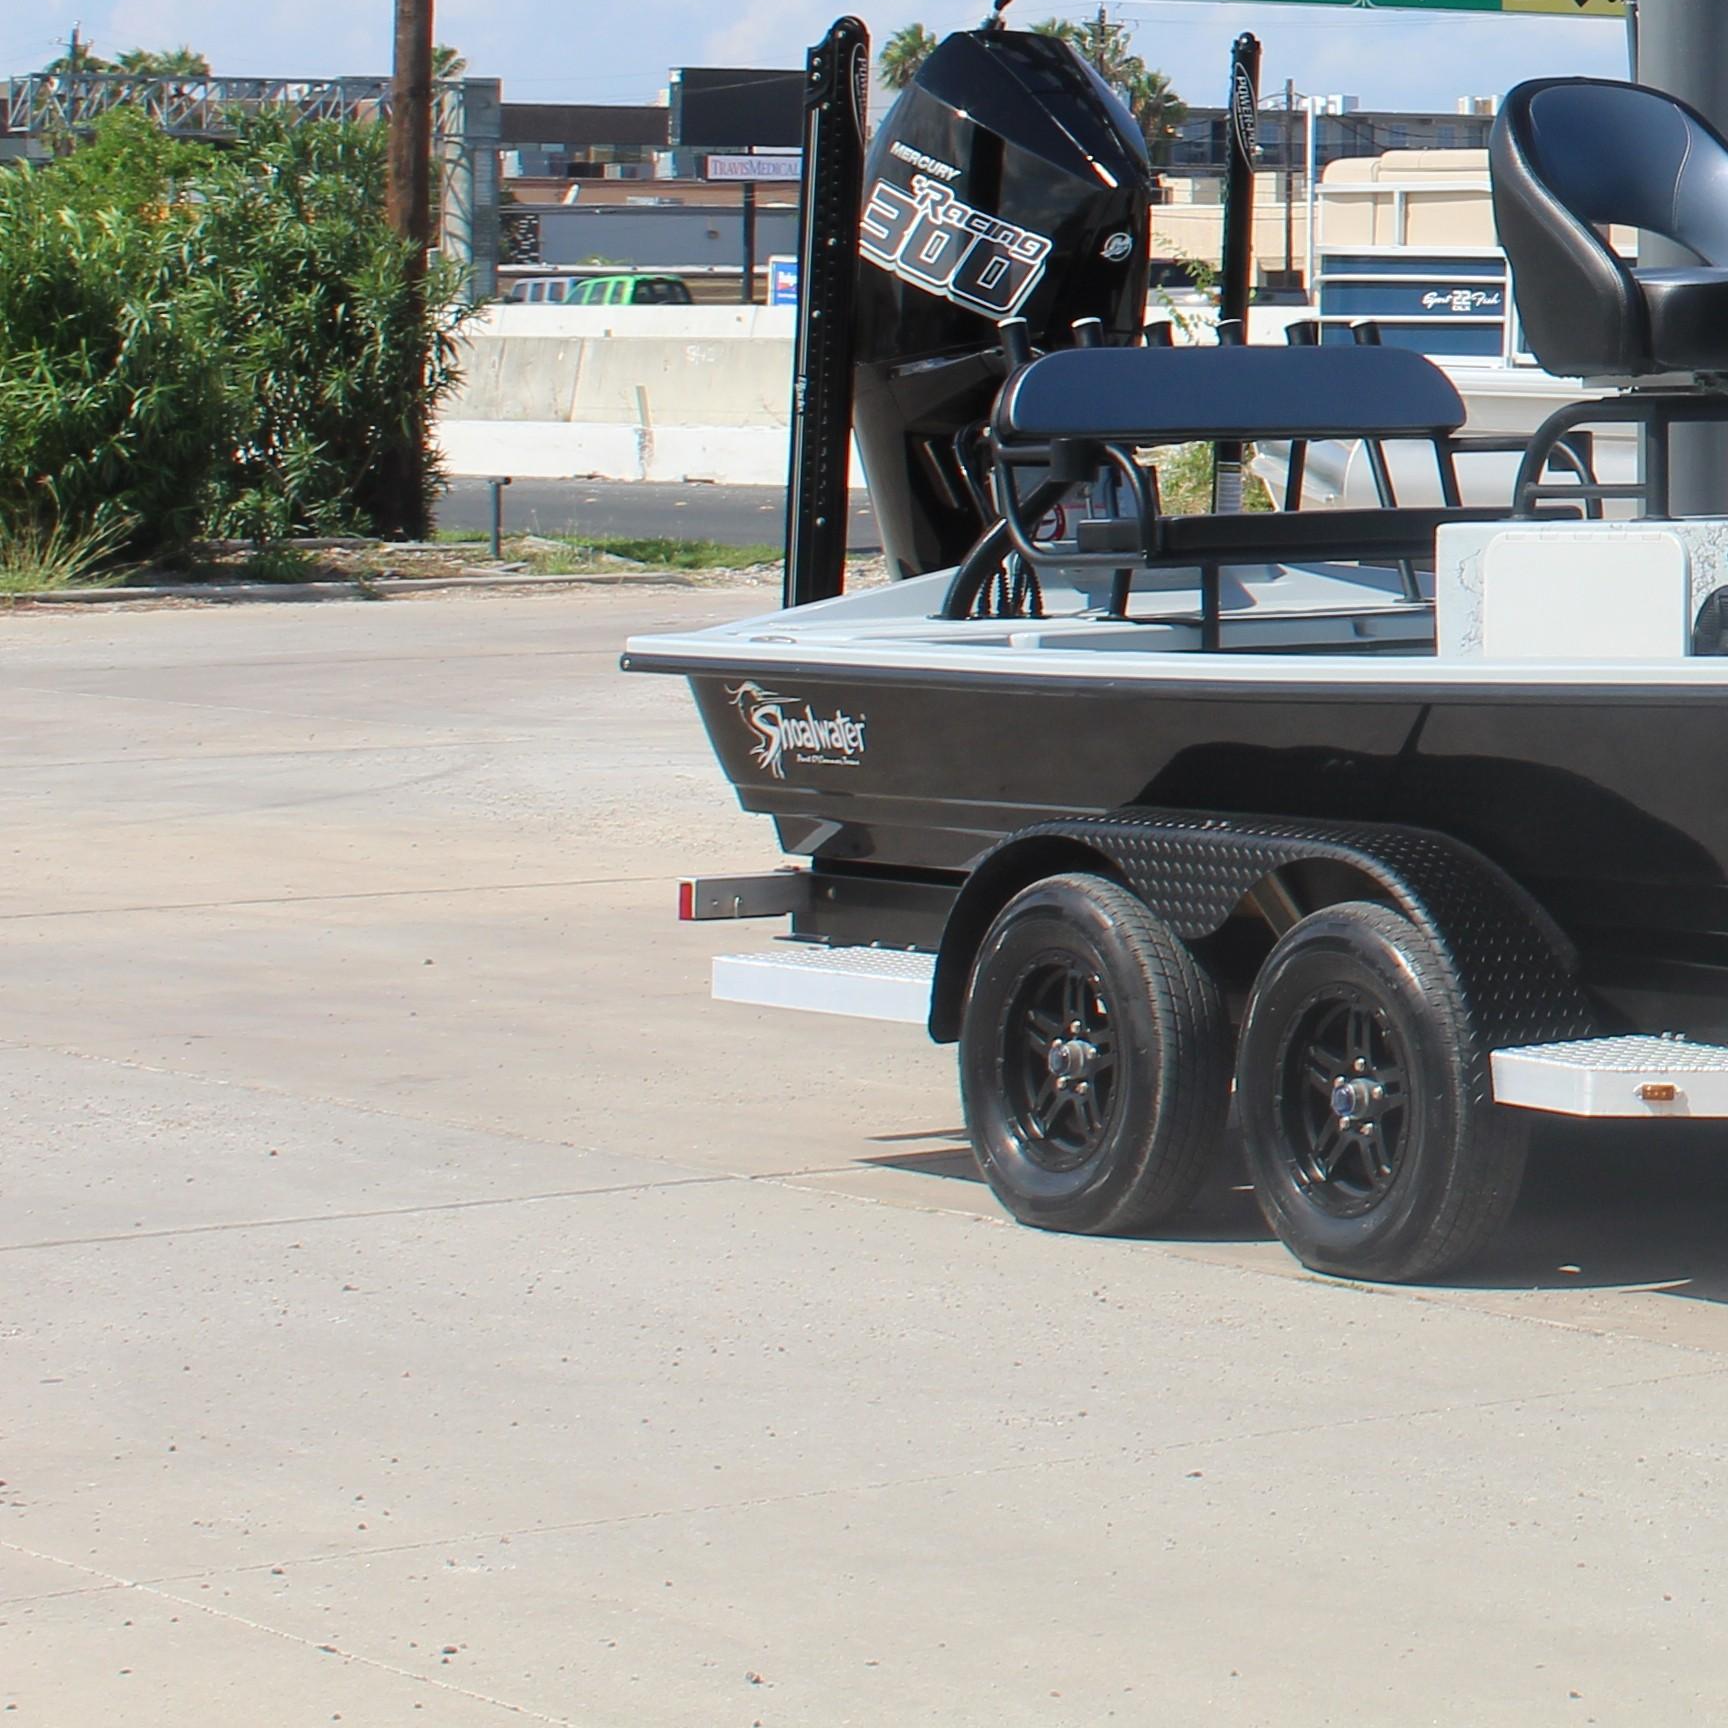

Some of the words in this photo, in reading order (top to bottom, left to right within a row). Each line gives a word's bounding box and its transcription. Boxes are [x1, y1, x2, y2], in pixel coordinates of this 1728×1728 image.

[889, 140, 962, 182] MERCURY
[911, 174, 1053, 265] Racing
[859, 177, 1047, 320] 300
[1452, 290, 1471, 305] 22
[751, 703, 866, 755] Shoalwater
